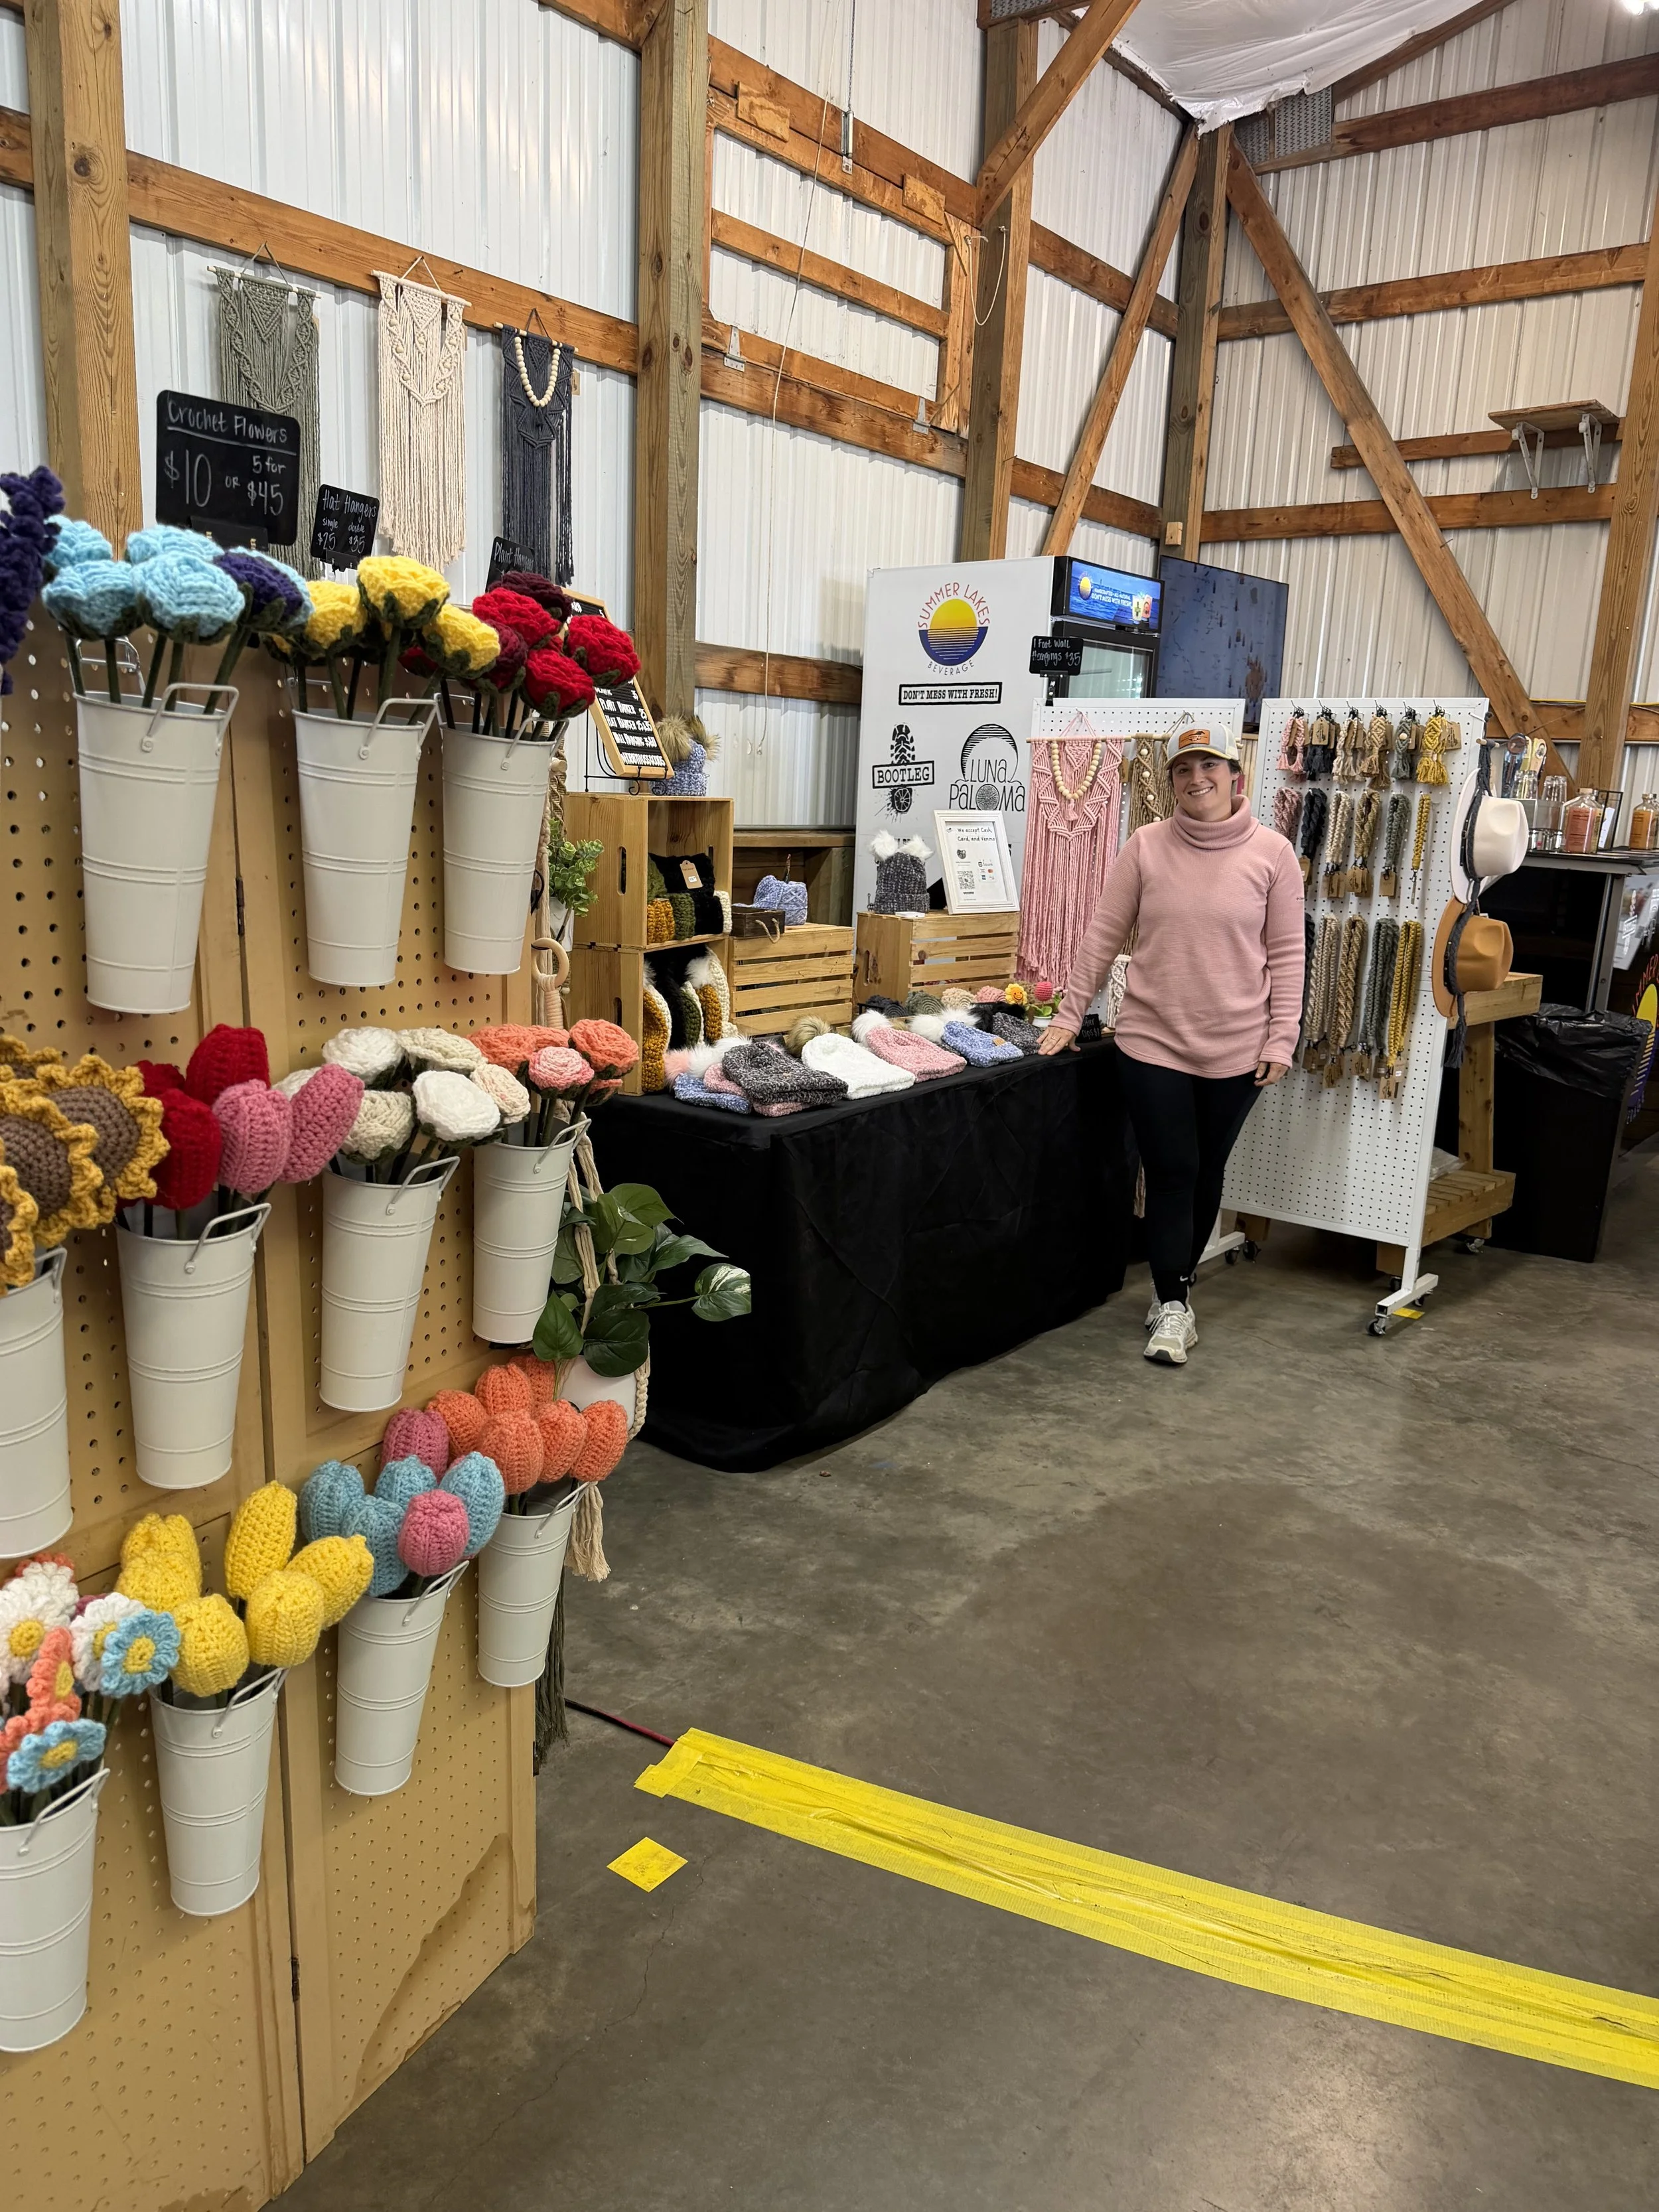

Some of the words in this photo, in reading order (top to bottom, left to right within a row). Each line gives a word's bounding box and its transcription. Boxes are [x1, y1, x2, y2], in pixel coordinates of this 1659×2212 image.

[167, 400, 228, 433] Crochet
[234, 415, 287, 444] Flowers
[252, 455, 262, 474] 5
[265, 456, 287, 475] for
[248, 480, 284, 516] $45
[322, 489, 340, 511] Hat
[344, 494, 377, 524] Hangers
[322, 517, 338, 531] single
[317, 532, 336, 550] $25
[348, 535, 366, 554] $35
[494, 542, 514, 564] Plant
[917, 581, 960, 629] SUMMER
[964, 584, 991, 625] LAKES
[1038, 638, 1052, 649] Foot
[1054, 638, 1070, 649] Wall
[927, 660, 975, 676] BEVERAGE
[1031, 650, 1062, 667] Hangings
[1065, 652, 1081, 666] $35
[903, 690, 925, 700] DON'T
[926, 690, 946, 700] MESS
[948, 689, 968, 699] WITH
[970, 688, 998, 699] FRESH!
[877, 767, 930, 784] BOOTLEG
